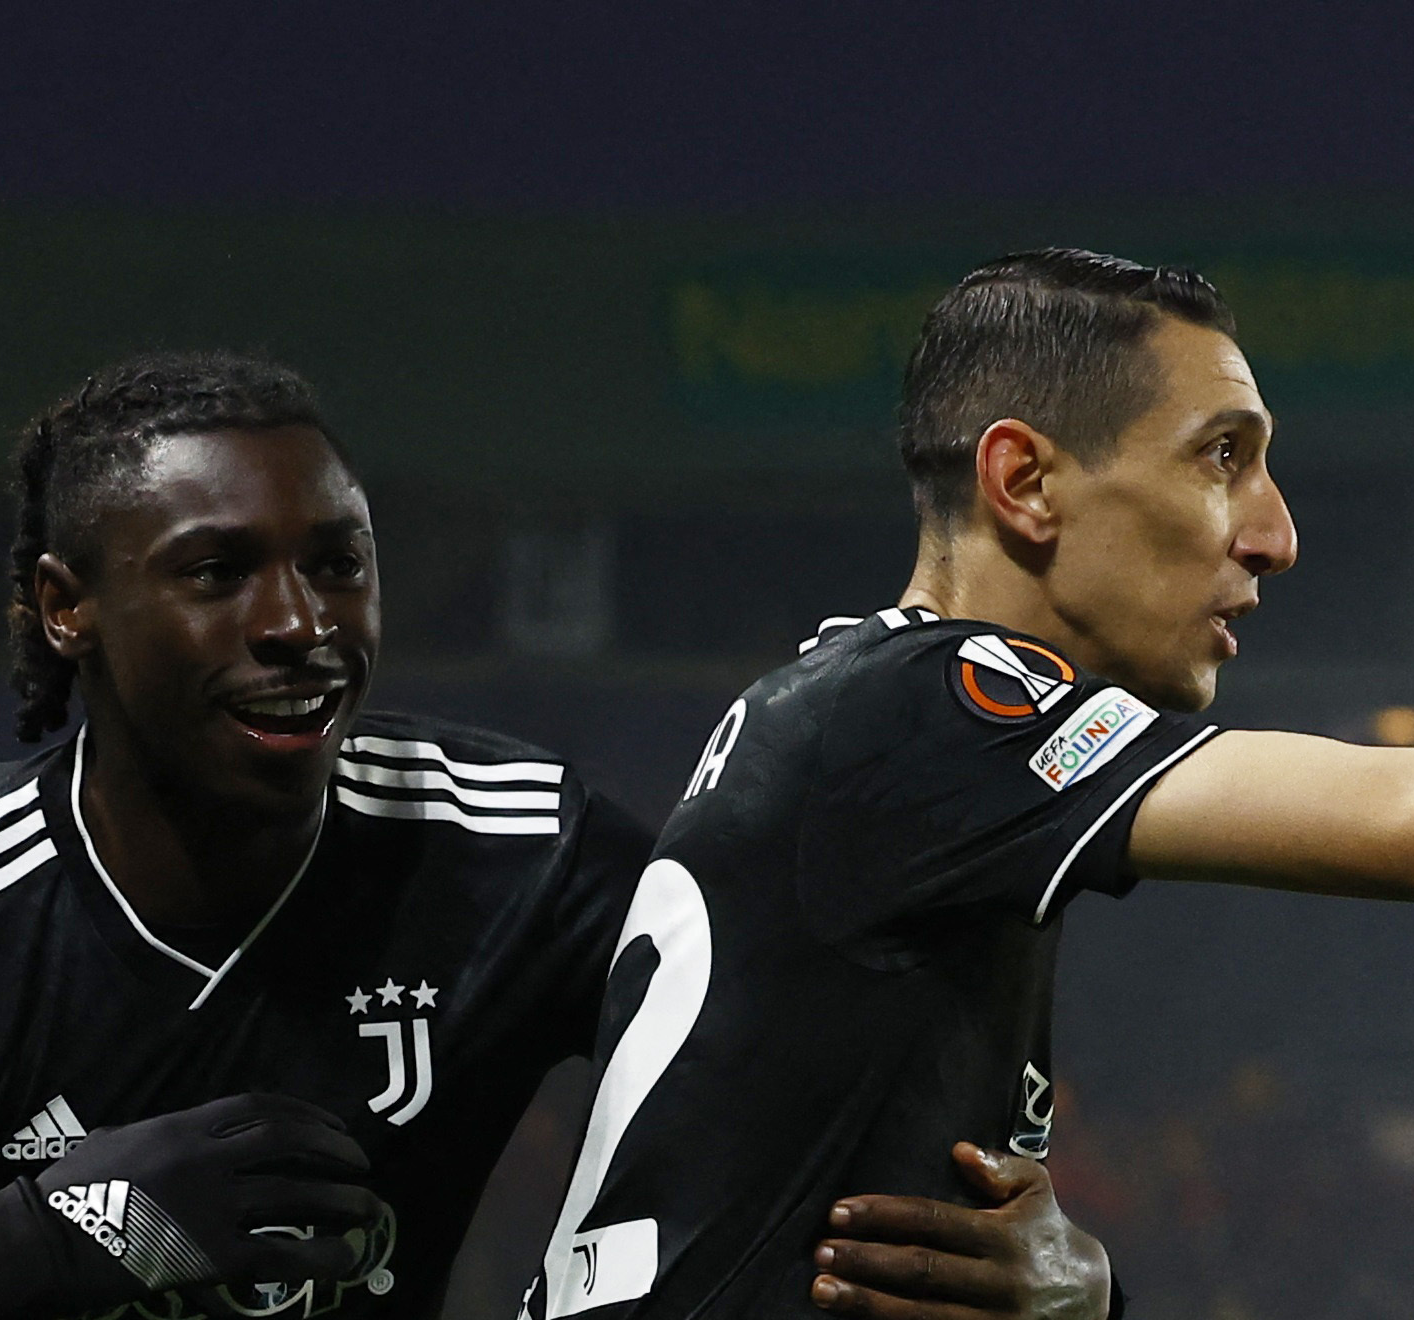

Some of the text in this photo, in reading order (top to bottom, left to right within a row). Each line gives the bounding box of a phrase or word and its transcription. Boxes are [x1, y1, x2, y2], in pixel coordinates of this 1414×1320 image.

[1035, 735, 1069, 771] UEFA
[1045, 698, 1139, 786] FOUNDAT
[2, 1135, 85, 1160] adid
[48, 1190, 127, 1257] adidas
